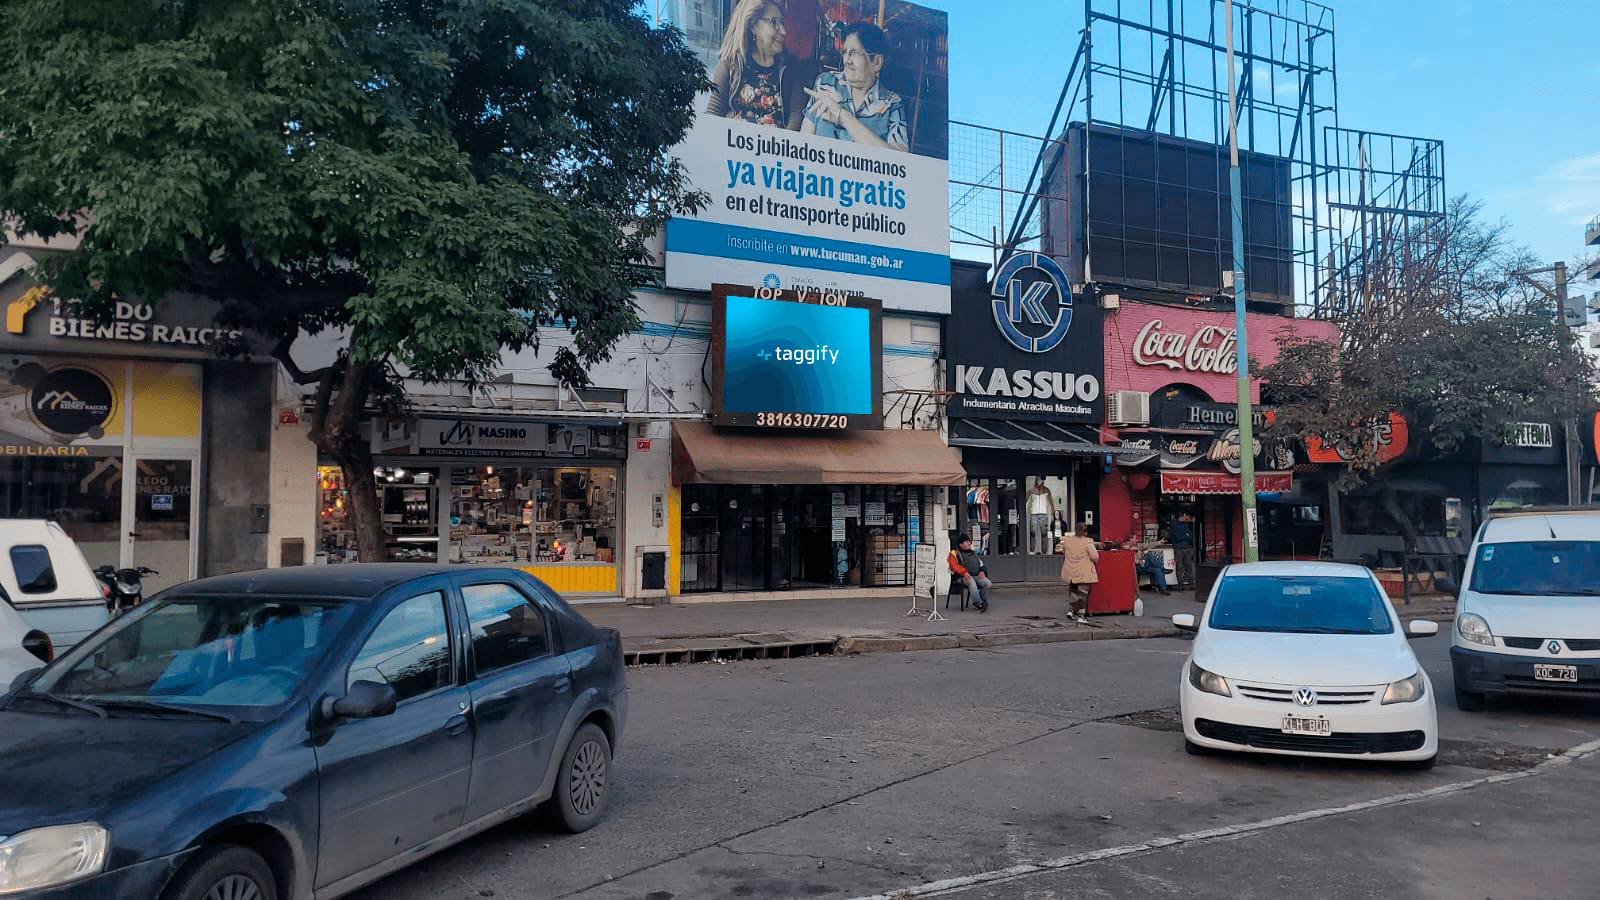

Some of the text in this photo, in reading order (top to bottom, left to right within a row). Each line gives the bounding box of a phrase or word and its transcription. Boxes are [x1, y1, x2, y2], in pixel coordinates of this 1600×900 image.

[727, 128, 906, 178] Los jubilados tucumanos
[727, 159, 906, 209] ya viajan gratis
[726, 195, 906, 236] en el transporte público
[727, 234, 903, 269] Inscribite en www.tucuman.gob.ar
[753, 286, 783, 301] TOP
[50, 317, 146, 341] BIENES
[775, 344, 840, 365] taggify
[955, 364, 1099, 402] KASSUO
[963, 398, 1092, 414] Indumentaria Atractiva Masculina
[756, 412, 848, 429] 3816307720
[479, 426, 527, 439] MASINO
[1283, 717, 1303, 731] KLH
